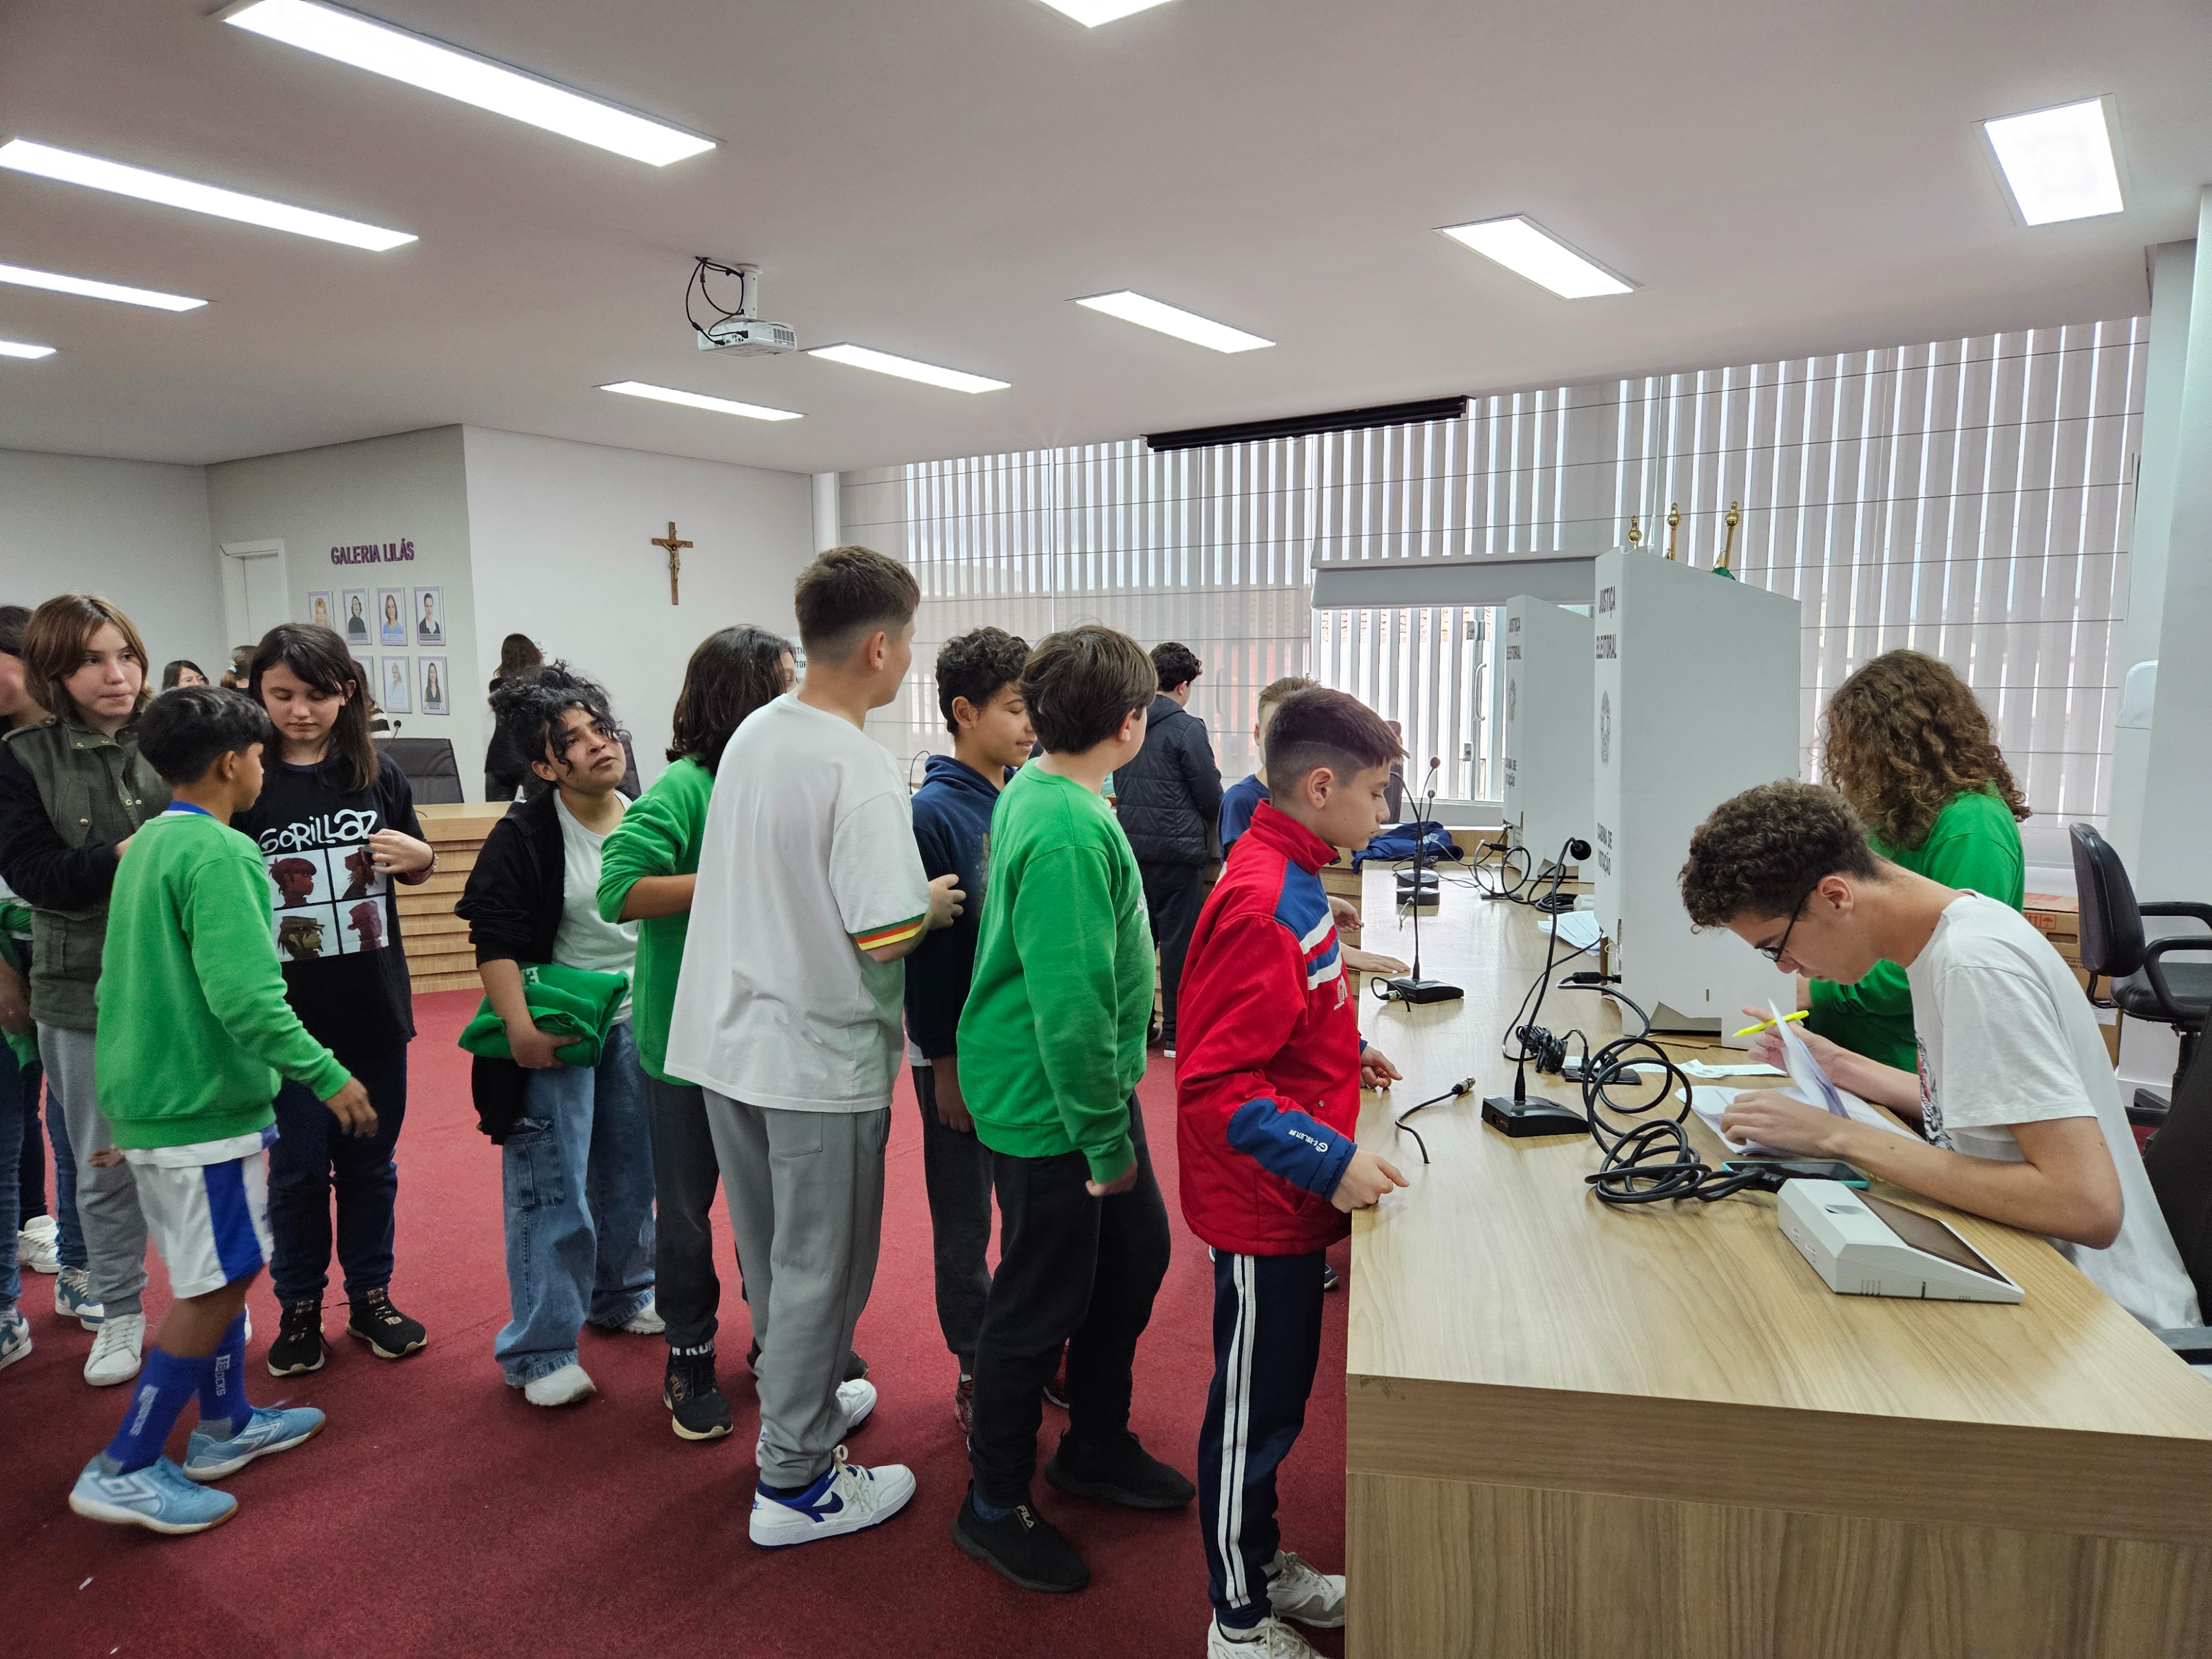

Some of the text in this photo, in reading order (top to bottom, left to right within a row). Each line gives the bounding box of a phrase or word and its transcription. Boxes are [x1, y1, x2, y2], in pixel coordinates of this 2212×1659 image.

[331, 538, 414, 565] GALERIA LILÁS
[1599, 586, 1616, 619] JUSTIÇA
[1596, 634, 1617, 659] ELEITORAL
[1016, 1505, 1035, 1528] FILA
